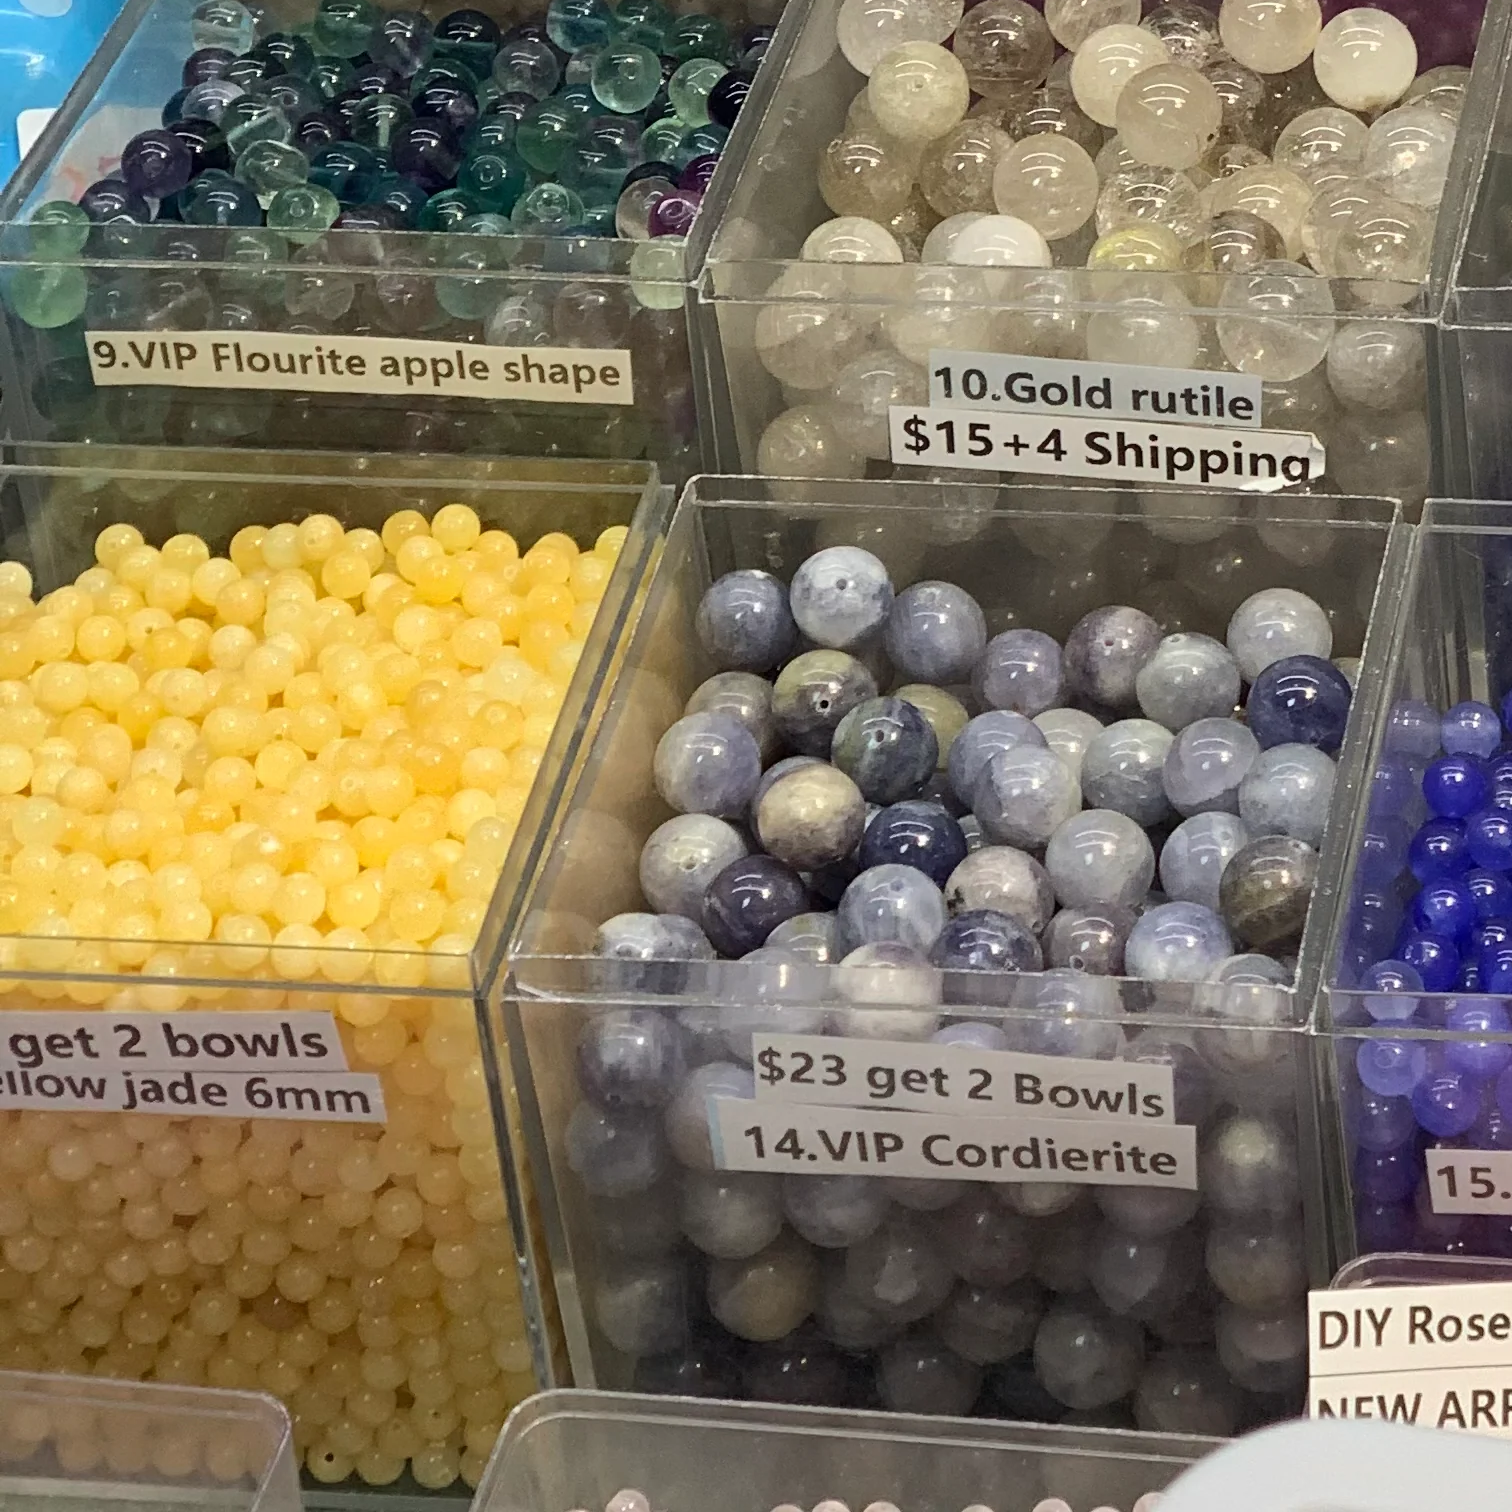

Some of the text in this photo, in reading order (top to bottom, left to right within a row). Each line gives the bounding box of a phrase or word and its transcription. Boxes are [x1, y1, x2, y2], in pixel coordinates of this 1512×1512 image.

[92, 341, 622, 393] 9.VIP Flourite apple shape
[934, 366, 1255, 421] 10.Gold rutile
[1084, 431, 1311, 484] Shipping
[8, 1022, 329, 1069] get 2 bowls
[0, 1069, 371, 1114] llow jade 6mm
[757, 1046, 1166, 1118] $23 get 2 Bowls
[743, 1125, 1178, 1177] 14.VIP Cordierite
[1318, 1307, 1392, 1351] DIY
[1408, 1305, 1511, 1344] Rose
